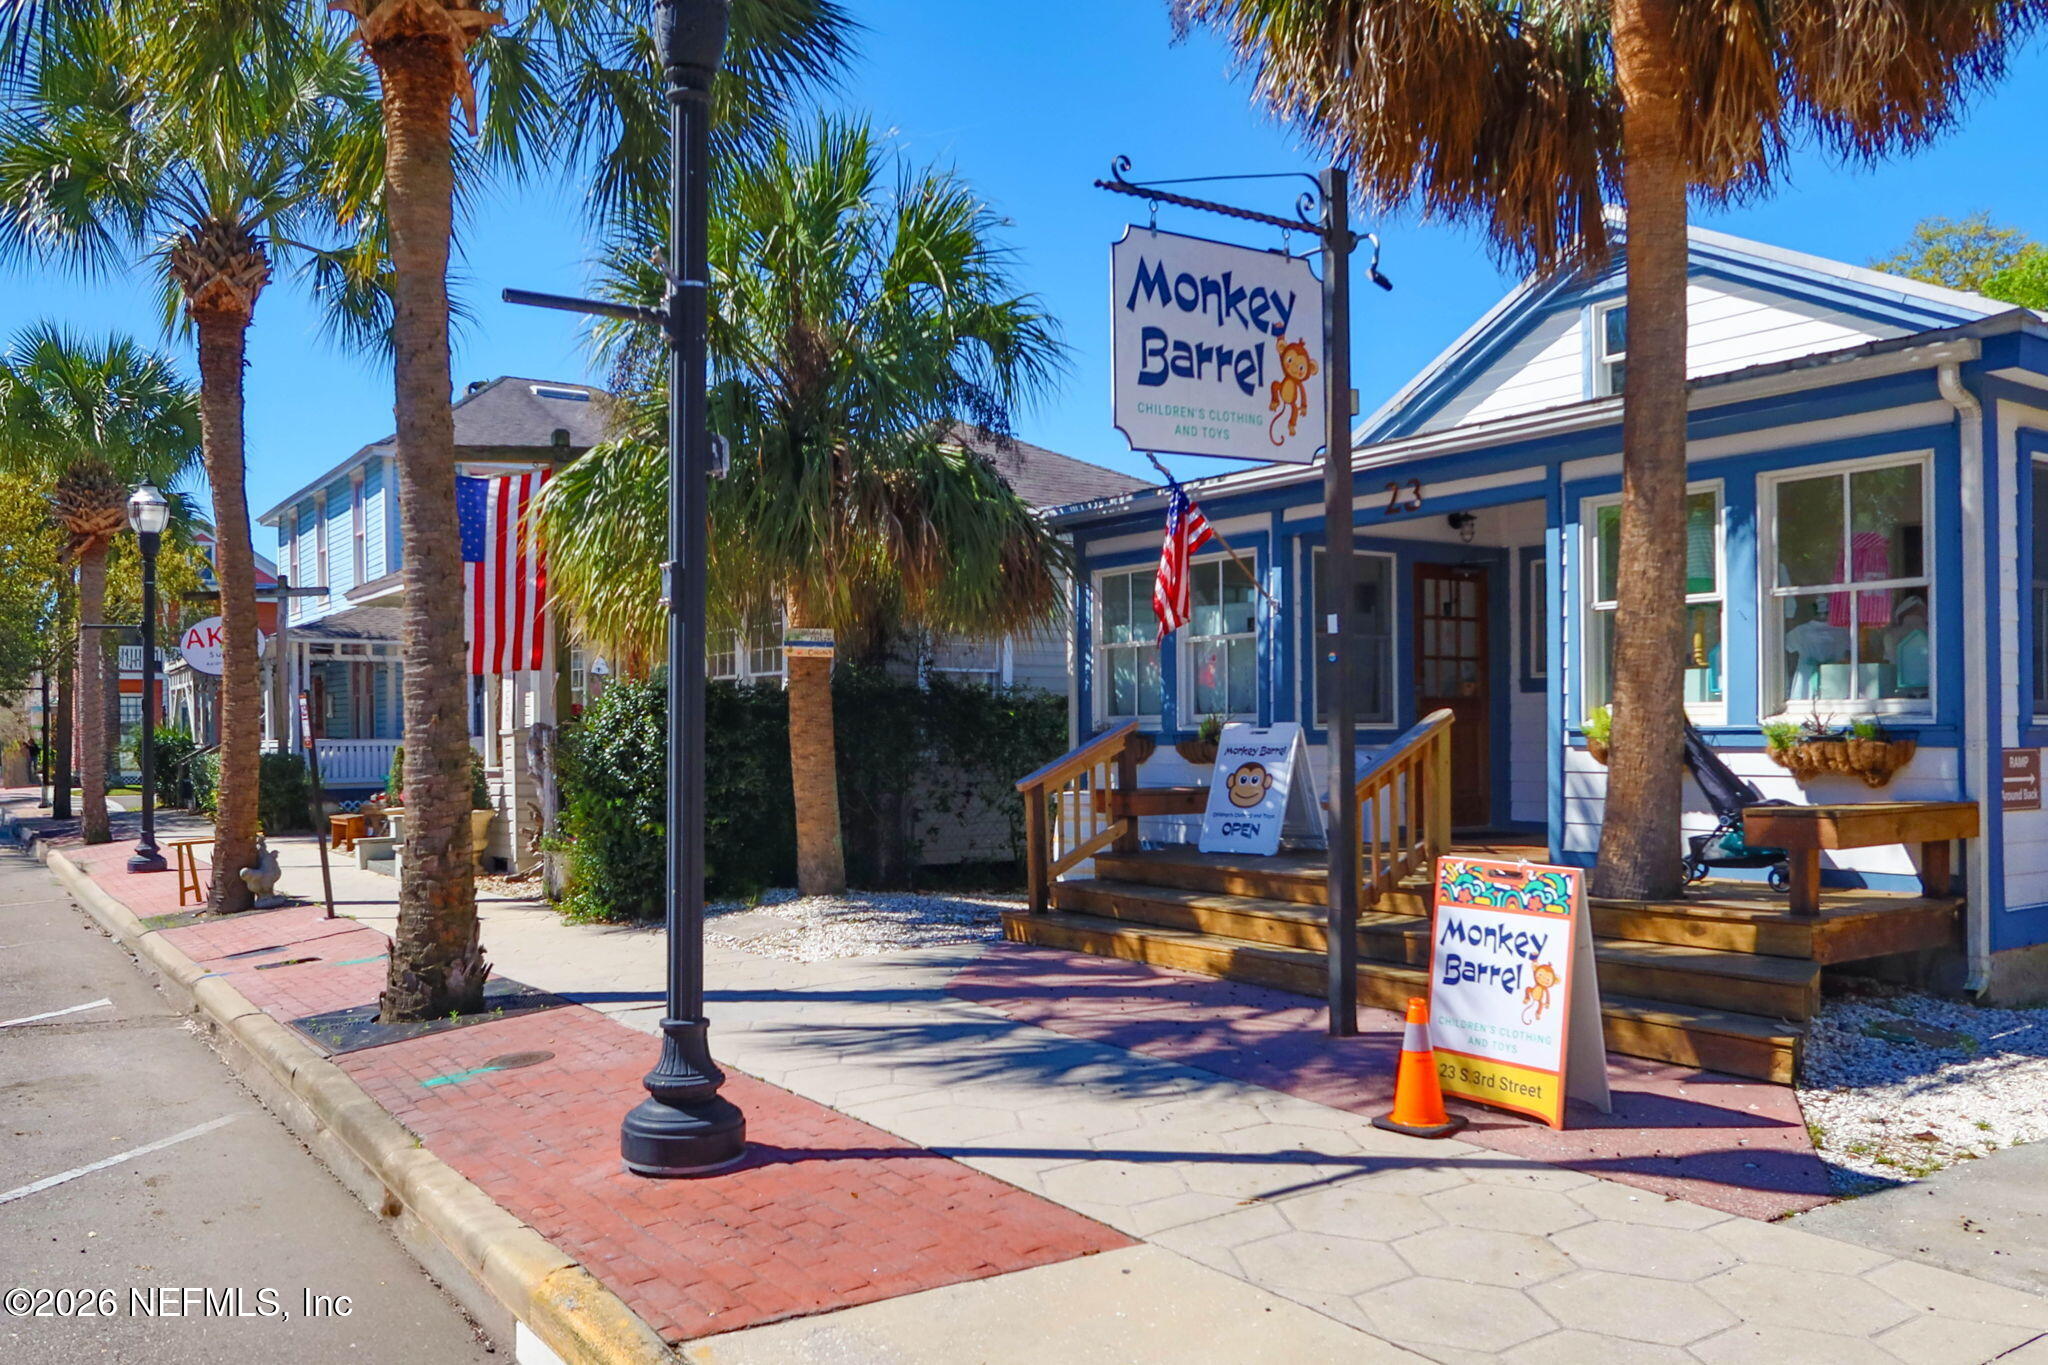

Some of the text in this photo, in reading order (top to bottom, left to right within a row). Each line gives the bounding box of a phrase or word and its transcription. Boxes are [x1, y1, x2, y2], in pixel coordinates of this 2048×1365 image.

[1126, 254, 1297, 338] Monkey
[1137, 325, 1266, 397] Barrel
[1137, 401, 1264, 426] CHILDREN'S CLOTHING
[1174, 424, 1230, 440] AND TOYS
[1384, 478, 1422, 516] 23
[186, 626, 223, 649] AK
[2009, 756, 2030, 769] RAMP
[1222, 822, 1260, 839] OPEN
[1440, 917, 1548, 962] Monkey
[1442, 953, 1523, 995] Barrel
[1438, 1015, 1553, 1046] CHILDREN'S CLOTHING
[1468, 1035, 1518, 1054] AND TOYS
[1440, 1062, 1456, 1080] 23
[1500, 1076, 1543, 1100] Street
